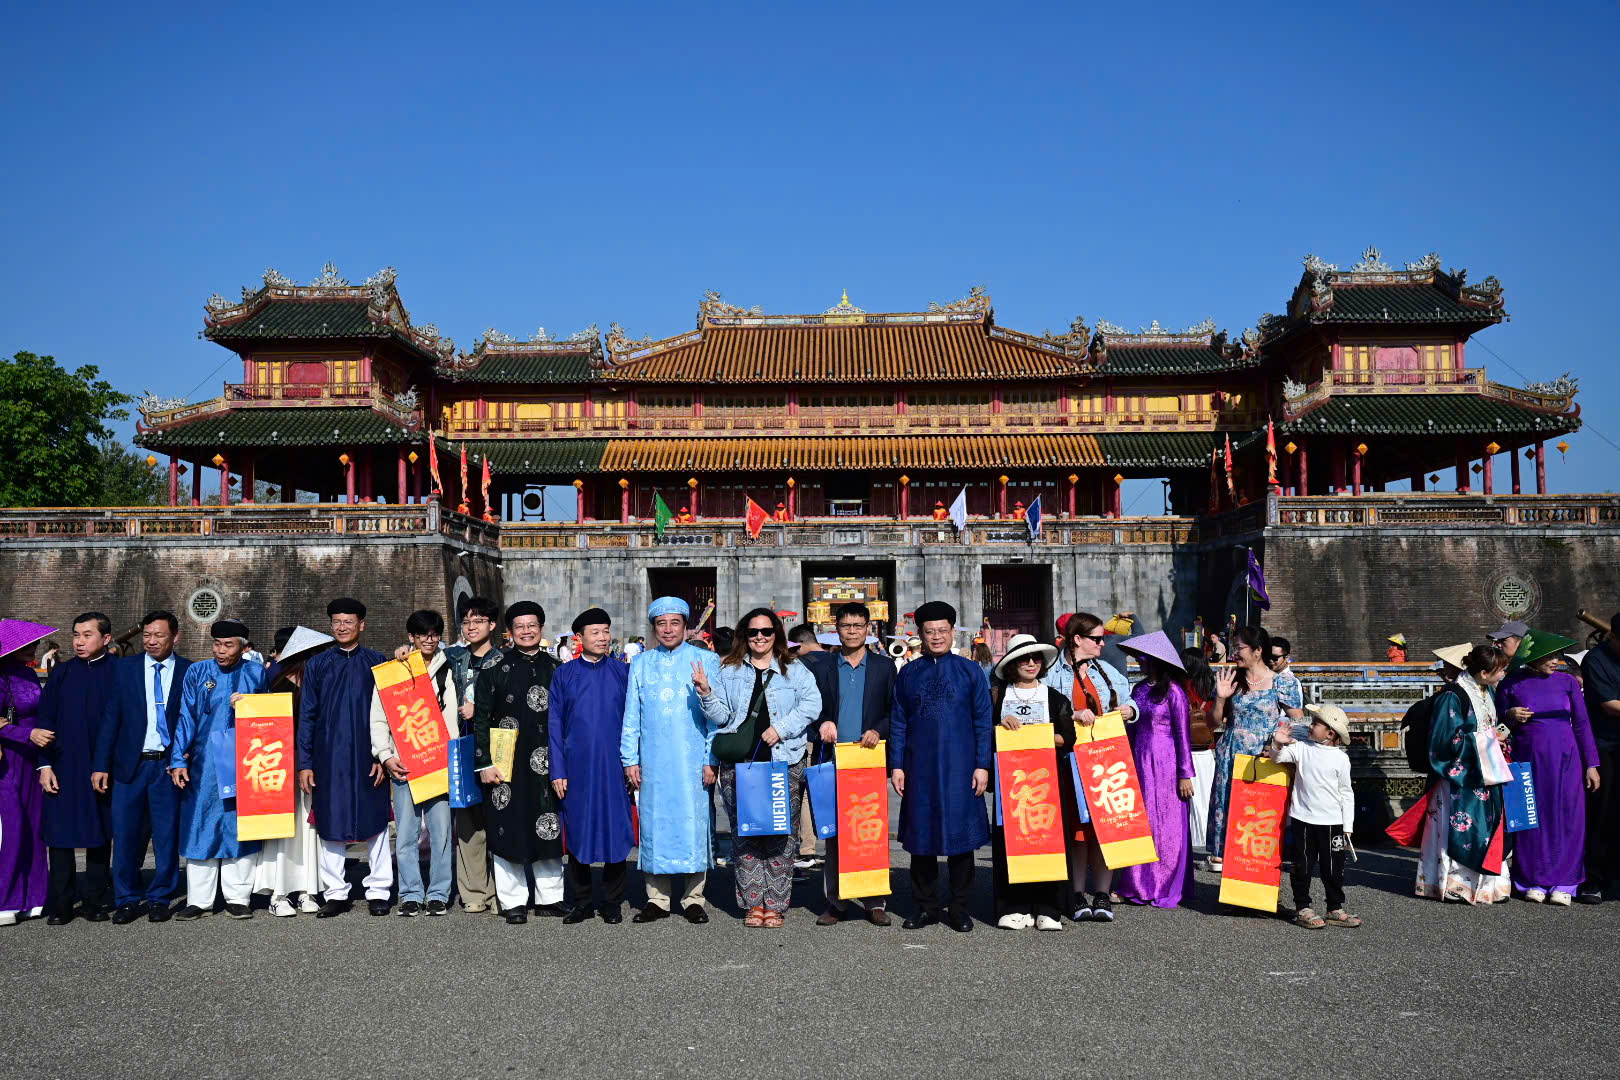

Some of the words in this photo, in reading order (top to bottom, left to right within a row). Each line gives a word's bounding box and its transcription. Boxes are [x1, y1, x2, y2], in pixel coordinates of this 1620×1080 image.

[397, 698, 440, 751] 福
[243, 738, 287, 792] 福
[1090, 761, 1135, 814] 福
[772, 772, 787, 831] HUEDISAN
[844, 791, 883, 843] 福
[1009, 768, 1056, 835] 福
[1521, 771, 1537, 825] HUEDISAN
[1235, 806, 1278, 859] 福
